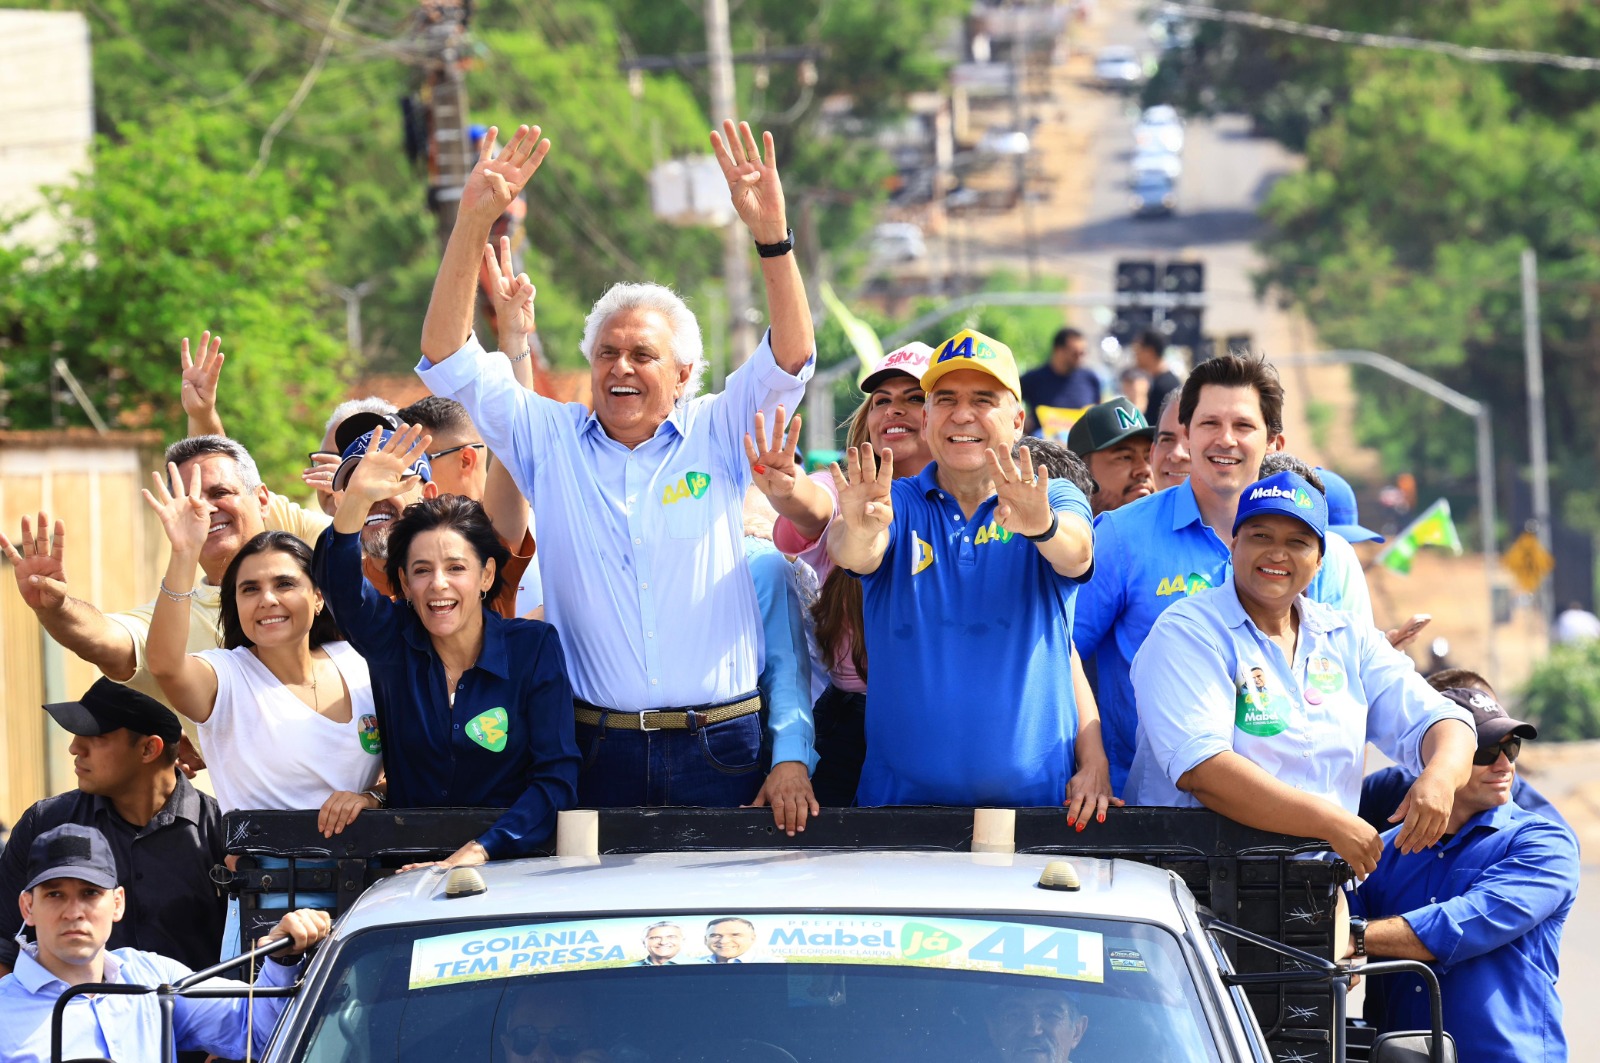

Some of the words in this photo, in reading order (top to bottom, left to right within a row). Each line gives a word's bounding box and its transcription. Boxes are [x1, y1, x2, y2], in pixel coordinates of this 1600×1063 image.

[937, 337, 975, 364] 44
[1114, 407, 1147, 429] M
[662, 478, 691, 505] 44
[1250, 486, 1296, 501] Mabel
[974, 521, 1000, 546] 44
[1156, 574, 1187, 596] 44
[479, 716, 505, 744] 44
[788, 920, 882, 928] PREFEITO
[461, 930, 599, 956] GOIÂNIA
[768, 928, 896, 948] Mabel
[903, 931, 950, 956] Já
[968, 926, 1087, 976] 44
[434, 956, 499, 978] TEM
[509, 944, 625, 969] PRESSA
